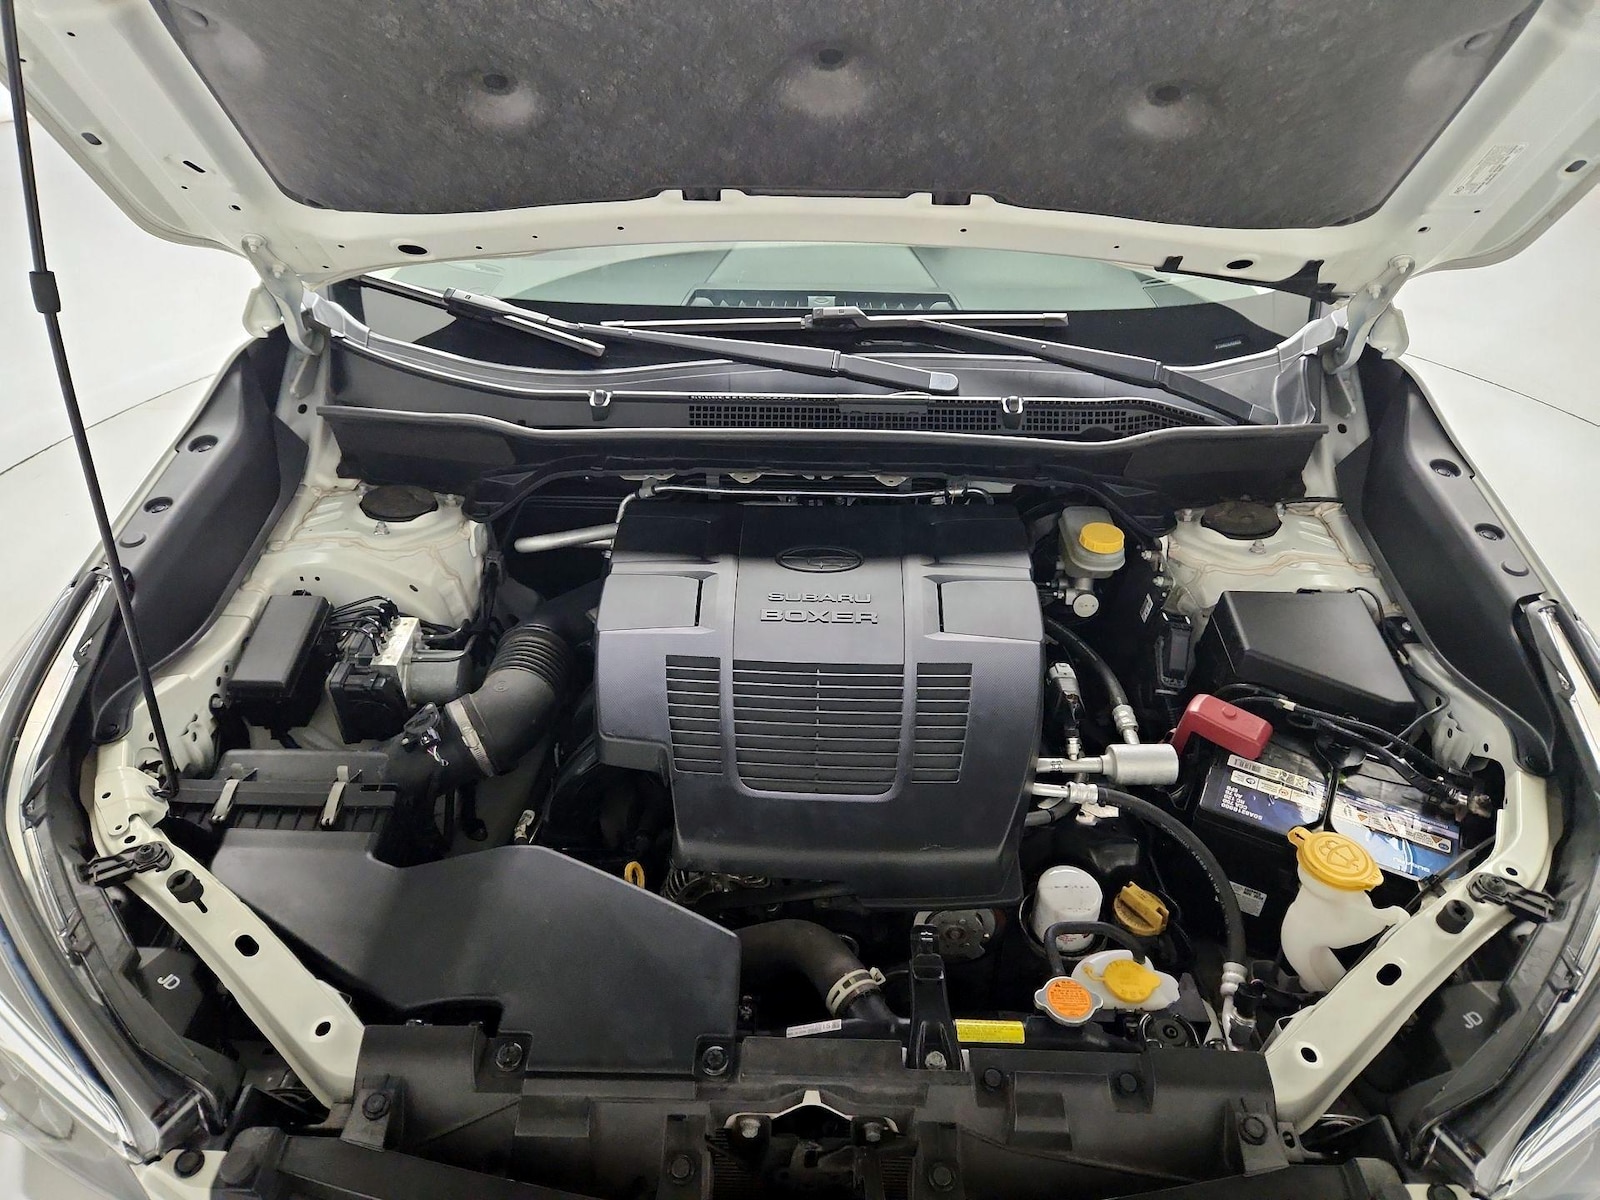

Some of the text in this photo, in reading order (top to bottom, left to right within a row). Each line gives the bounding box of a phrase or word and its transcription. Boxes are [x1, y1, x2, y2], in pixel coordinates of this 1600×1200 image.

[768, 591, 871, 603] SUBARU
[760, 608, 878, 624] BOXER
[158, 973, 181, 991] JD
[1463, 1011, 1483, 1029] JD
